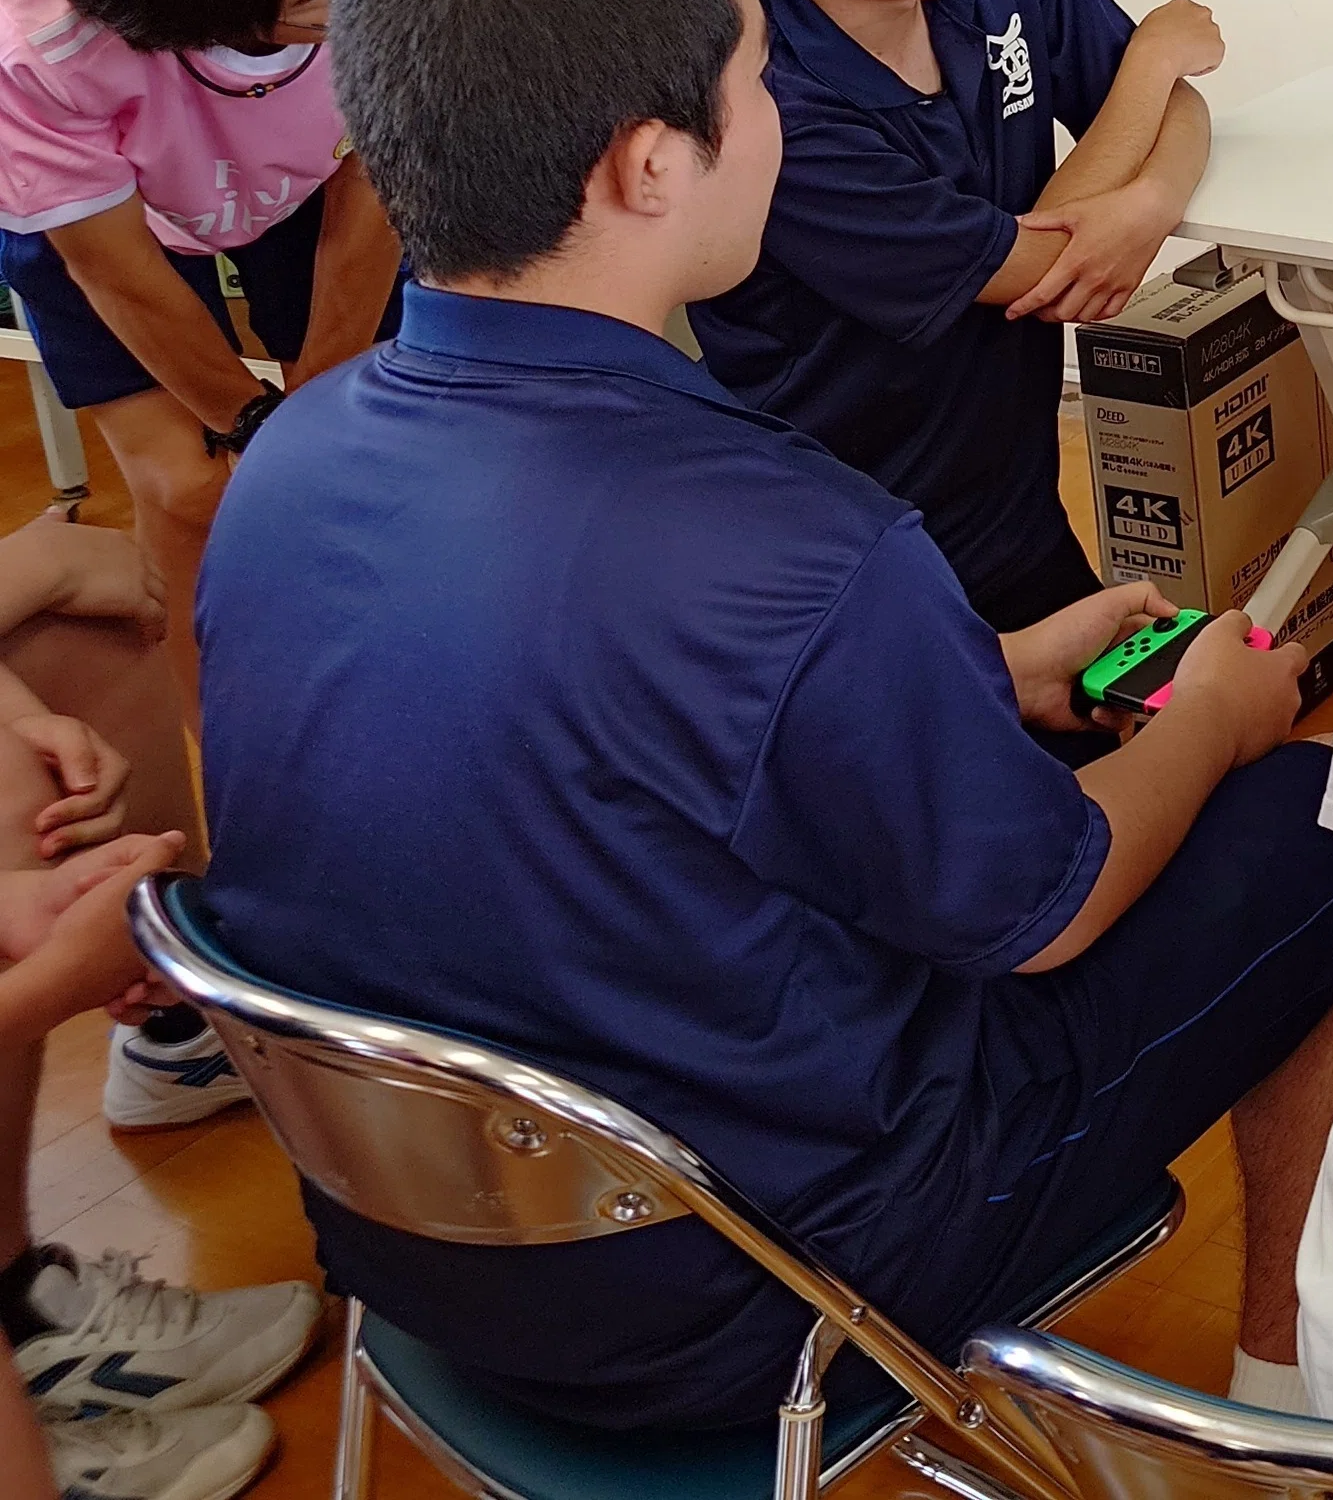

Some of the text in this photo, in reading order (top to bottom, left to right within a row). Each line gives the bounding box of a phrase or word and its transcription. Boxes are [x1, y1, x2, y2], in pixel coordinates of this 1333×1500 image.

[1201, 317, 1253, 367] M2804K
[1096, 407, 1126, 422] DEED
[1214, 375, 1267, 425] HDMI
[1226, 415, 1266, 459] 4K
[1230, 447, 1264, 481] UHD
[1116, 495, 1171, 522] 4K
[1122, 520, 1169, 540] UHD
[1110, 546, 1183, 574] HDMI
